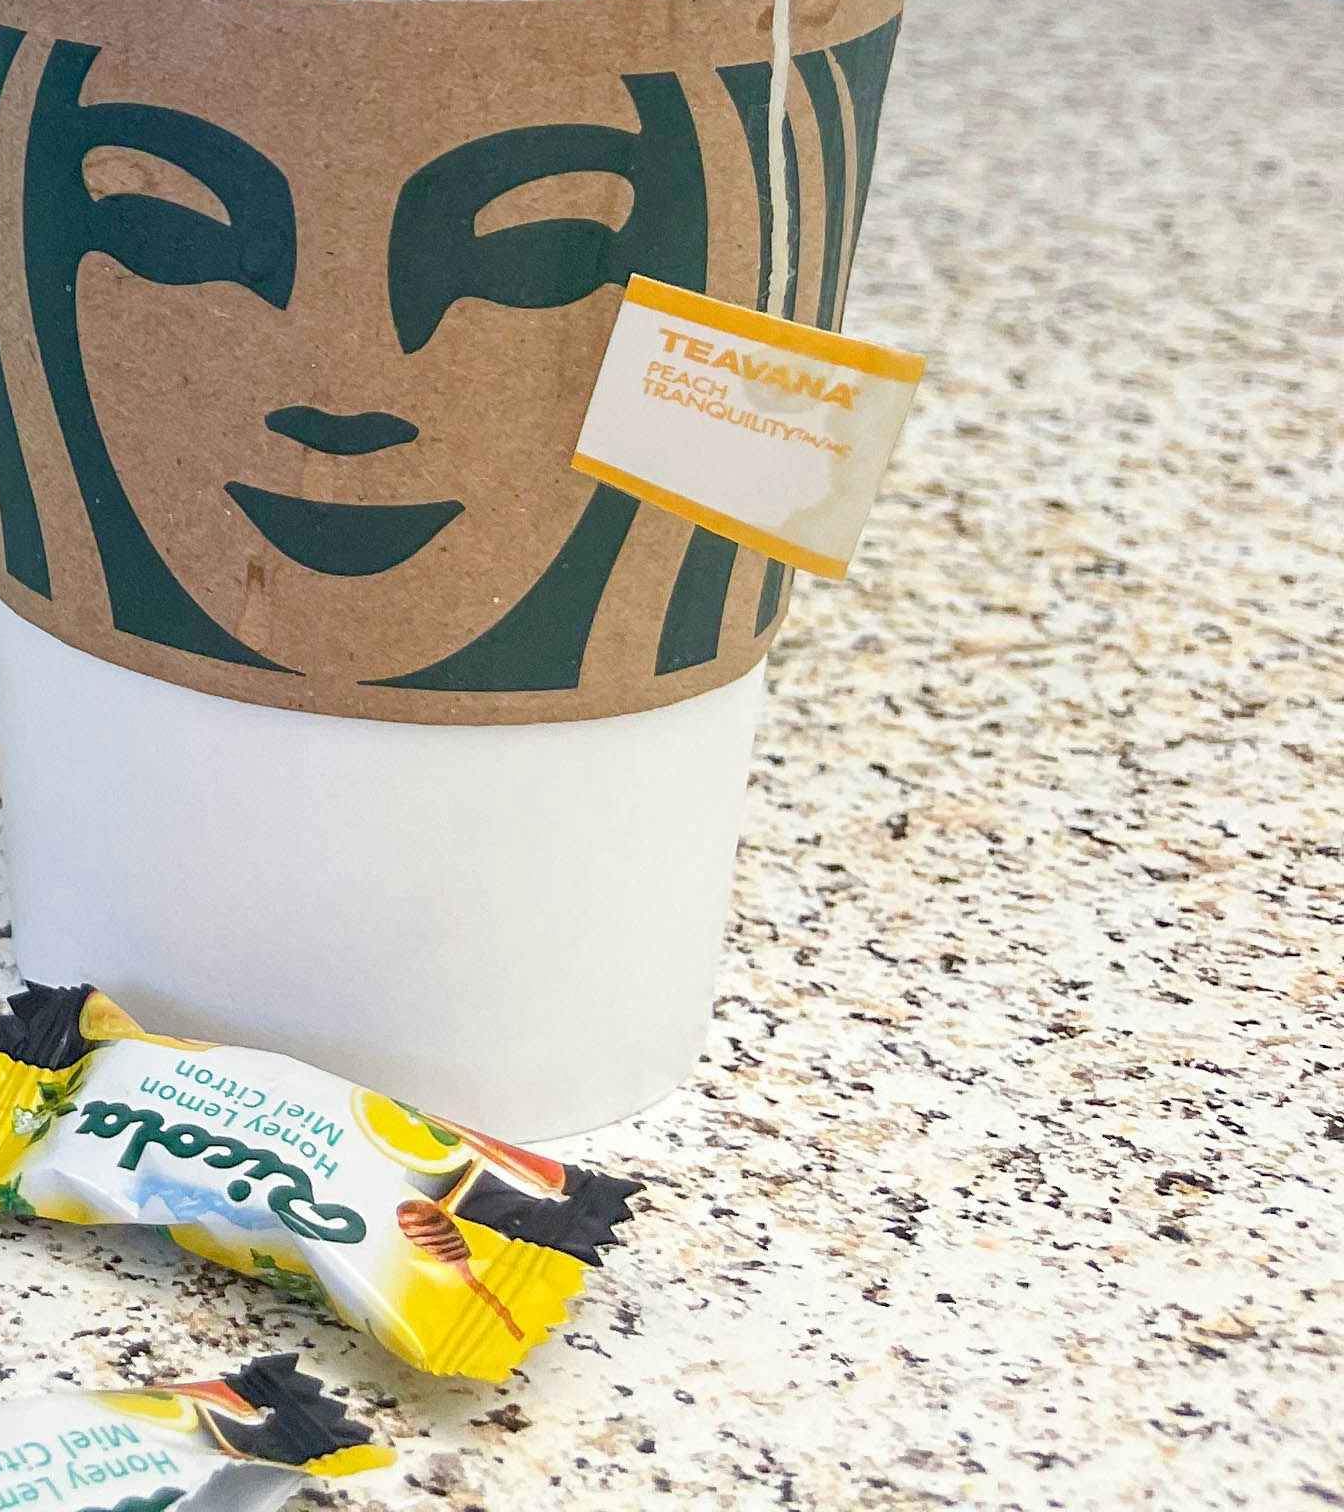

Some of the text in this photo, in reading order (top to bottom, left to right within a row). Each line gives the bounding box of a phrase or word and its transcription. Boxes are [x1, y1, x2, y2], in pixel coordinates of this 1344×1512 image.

[647, 360, 729, 400] PEACH
[659, 328, 857, 410] TEAVANA
[643, 377, 800, 441] TRANQUILITY
[139, 1076, 339, 1179] Honey Lemon
[175, 1059, 345, 1147] Miel Citron
[75, 1100, 367, 1244] Ricola
[57, 1423, 142, 1460] Miel
[67, 1451, 180, 1489] Honey
